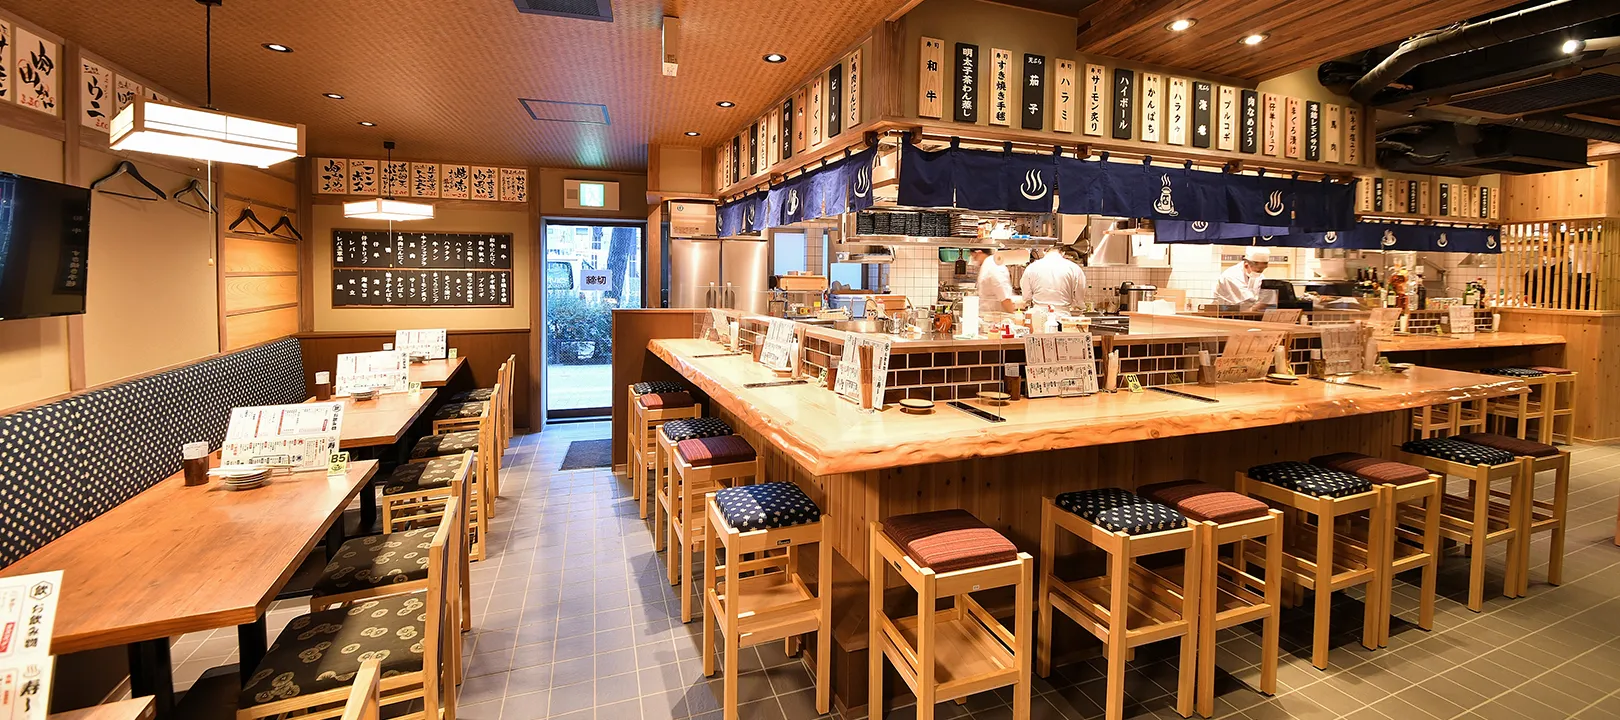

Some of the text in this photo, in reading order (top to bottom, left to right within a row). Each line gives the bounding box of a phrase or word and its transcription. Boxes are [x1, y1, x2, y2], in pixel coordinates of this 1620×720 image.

[926, 41, 940, 49] 寿司
[996, 52, 1008, 60] 寿司
[926, 59, 938, 102] 和牛
[962, 47, 973, 117] 明太子茶わん蒸し
[996, 60, 1007, 121] すき焼き手毬
[1028, 75, 1040, 115] 茄子
[1060, 77, 1071, 120] ハラミ
[1090, 76, 1100, 132] サーモン炙り
[1119, 76, 1130, 130] ハイボール
[348, 240, 356, 258] レバー
[432, 241, 440, 261] 牛タン
[500, 243, 508, 260] 和牛
[585, 275, 607, 285] 締切
[330, 453, 347, 464] B5
[33, 584, 49, 597] 飲
[25, 604, 44, 648] お飲み物
